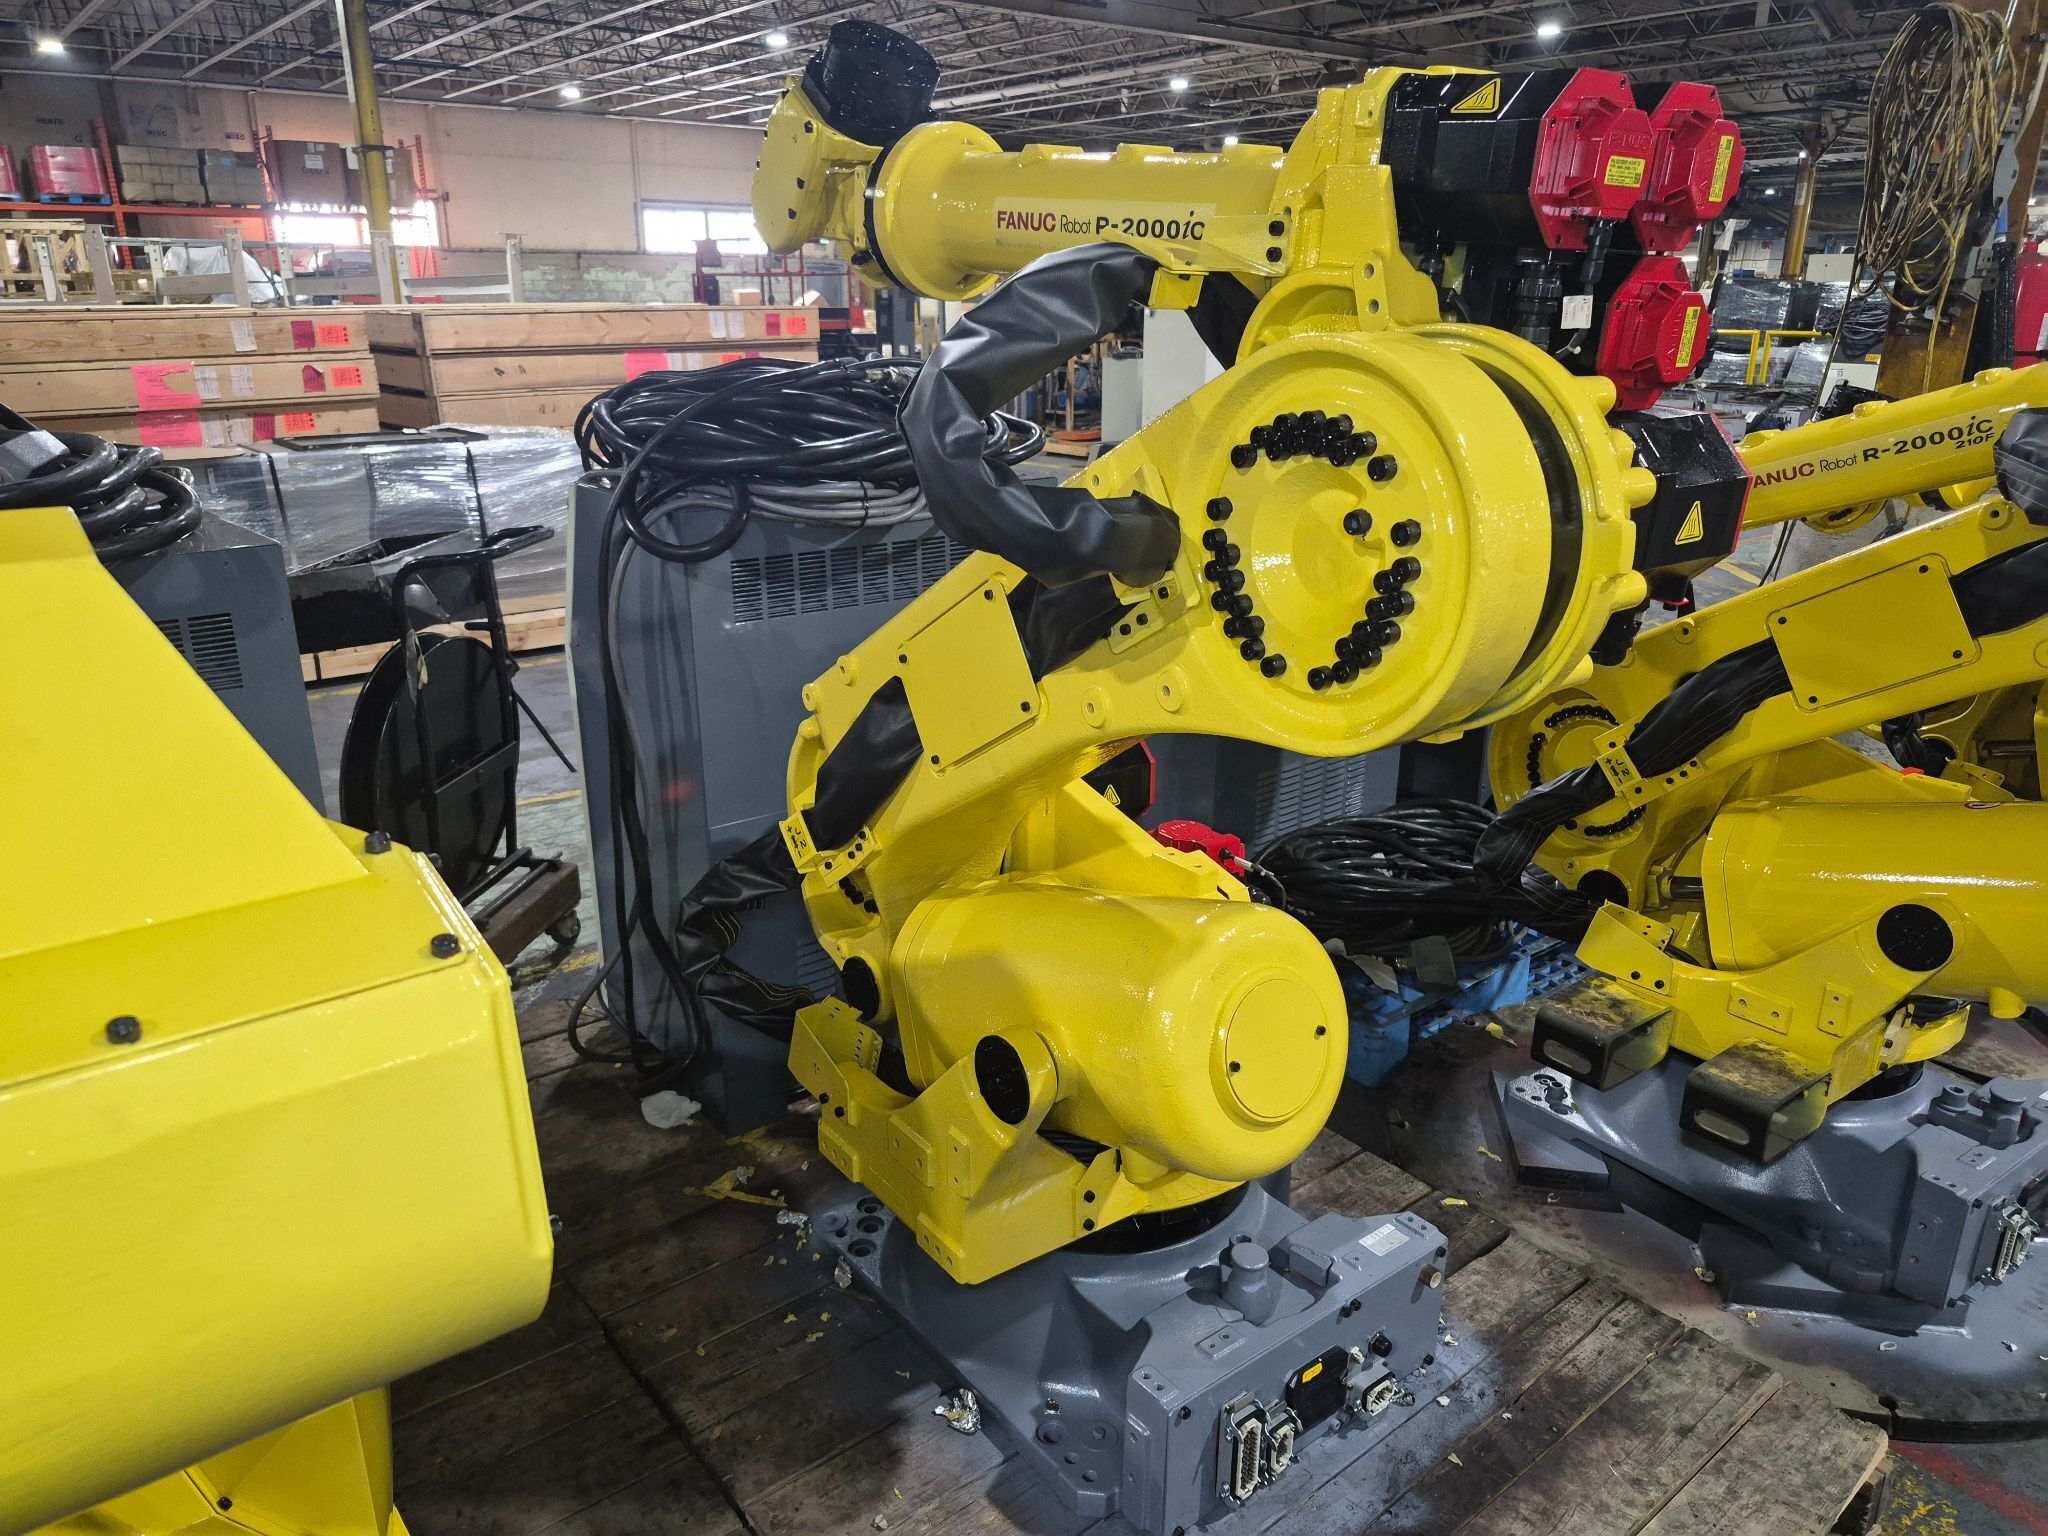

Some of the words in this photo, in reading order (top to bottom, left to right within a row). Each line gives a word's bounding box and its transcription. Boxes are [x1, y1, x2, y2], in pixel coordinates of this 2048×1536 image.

[997, 210, 1057, 233] FANUC
[1060, 214, 1092, 235] Robot
[1753, 461, 1816, 489] ANUC
[1819, 452, 1859, 473] Robot
[1862, 415, 1995, 463] R-2000iC
[1954, 432, 1996, 450] 210F
